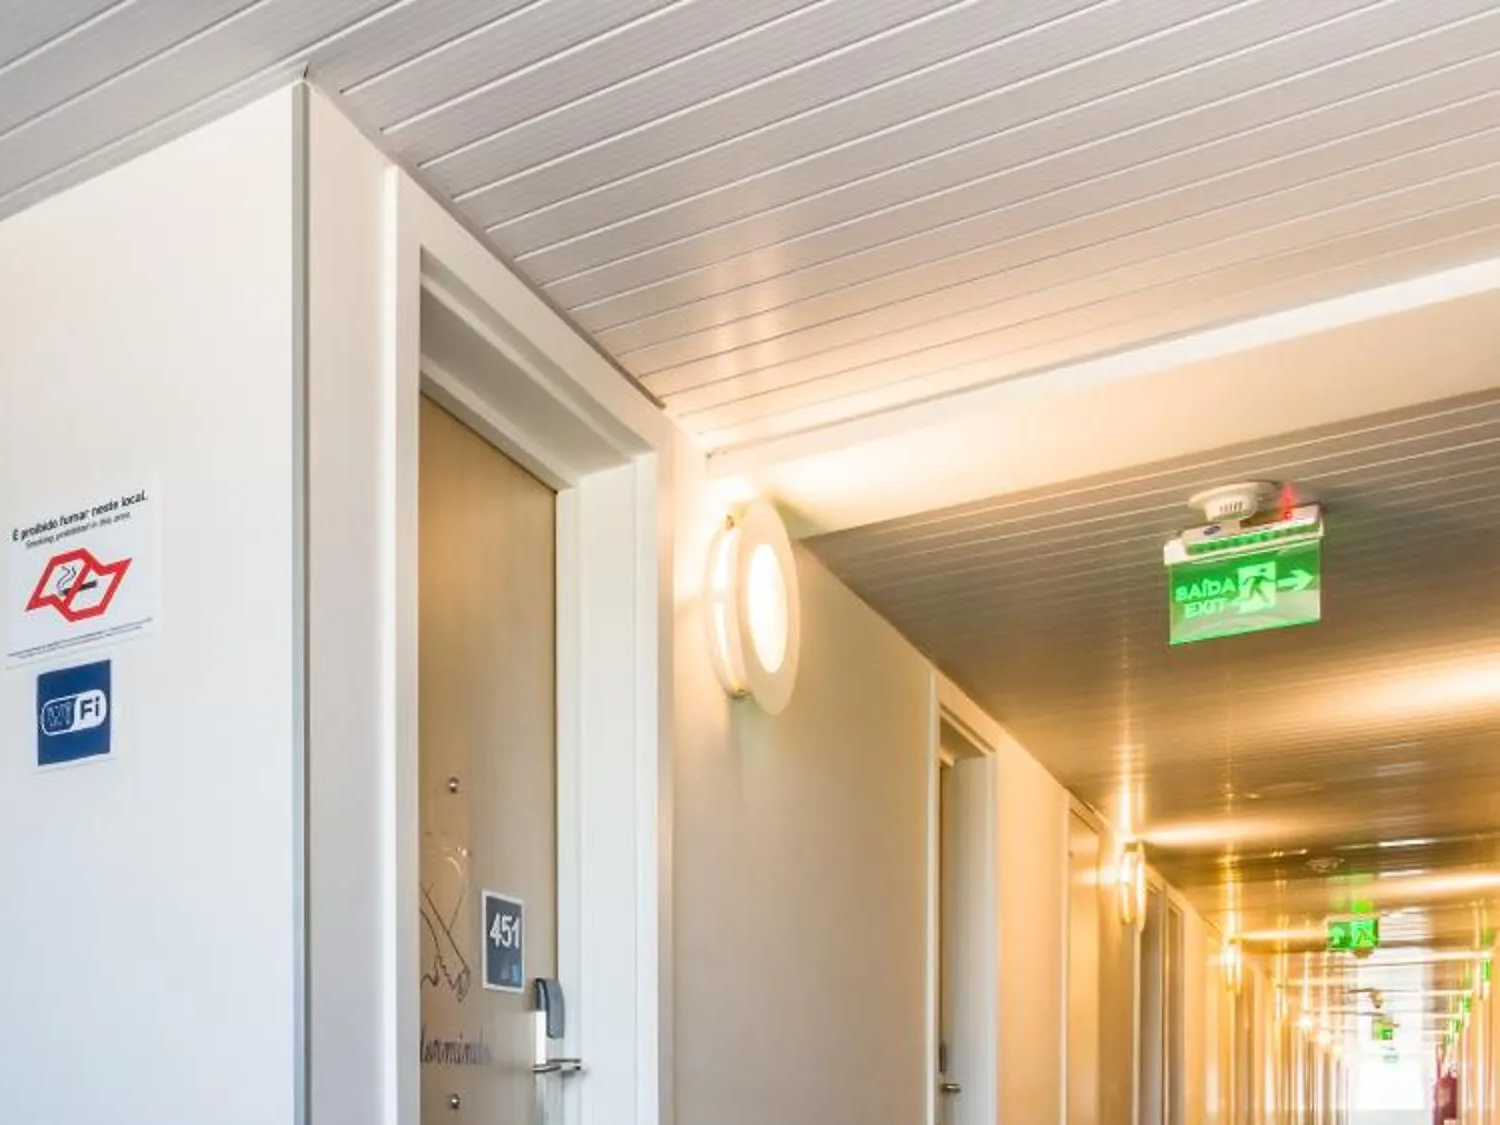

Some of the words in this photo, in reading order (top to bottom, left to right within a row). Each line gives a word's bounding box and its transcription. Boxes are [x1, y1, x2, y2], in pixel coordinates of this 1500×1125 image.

[60, 509, 90, 526] fumar
[1184, 597, 1227, 619] EXIT
[489, 912, 520, 949] 451
